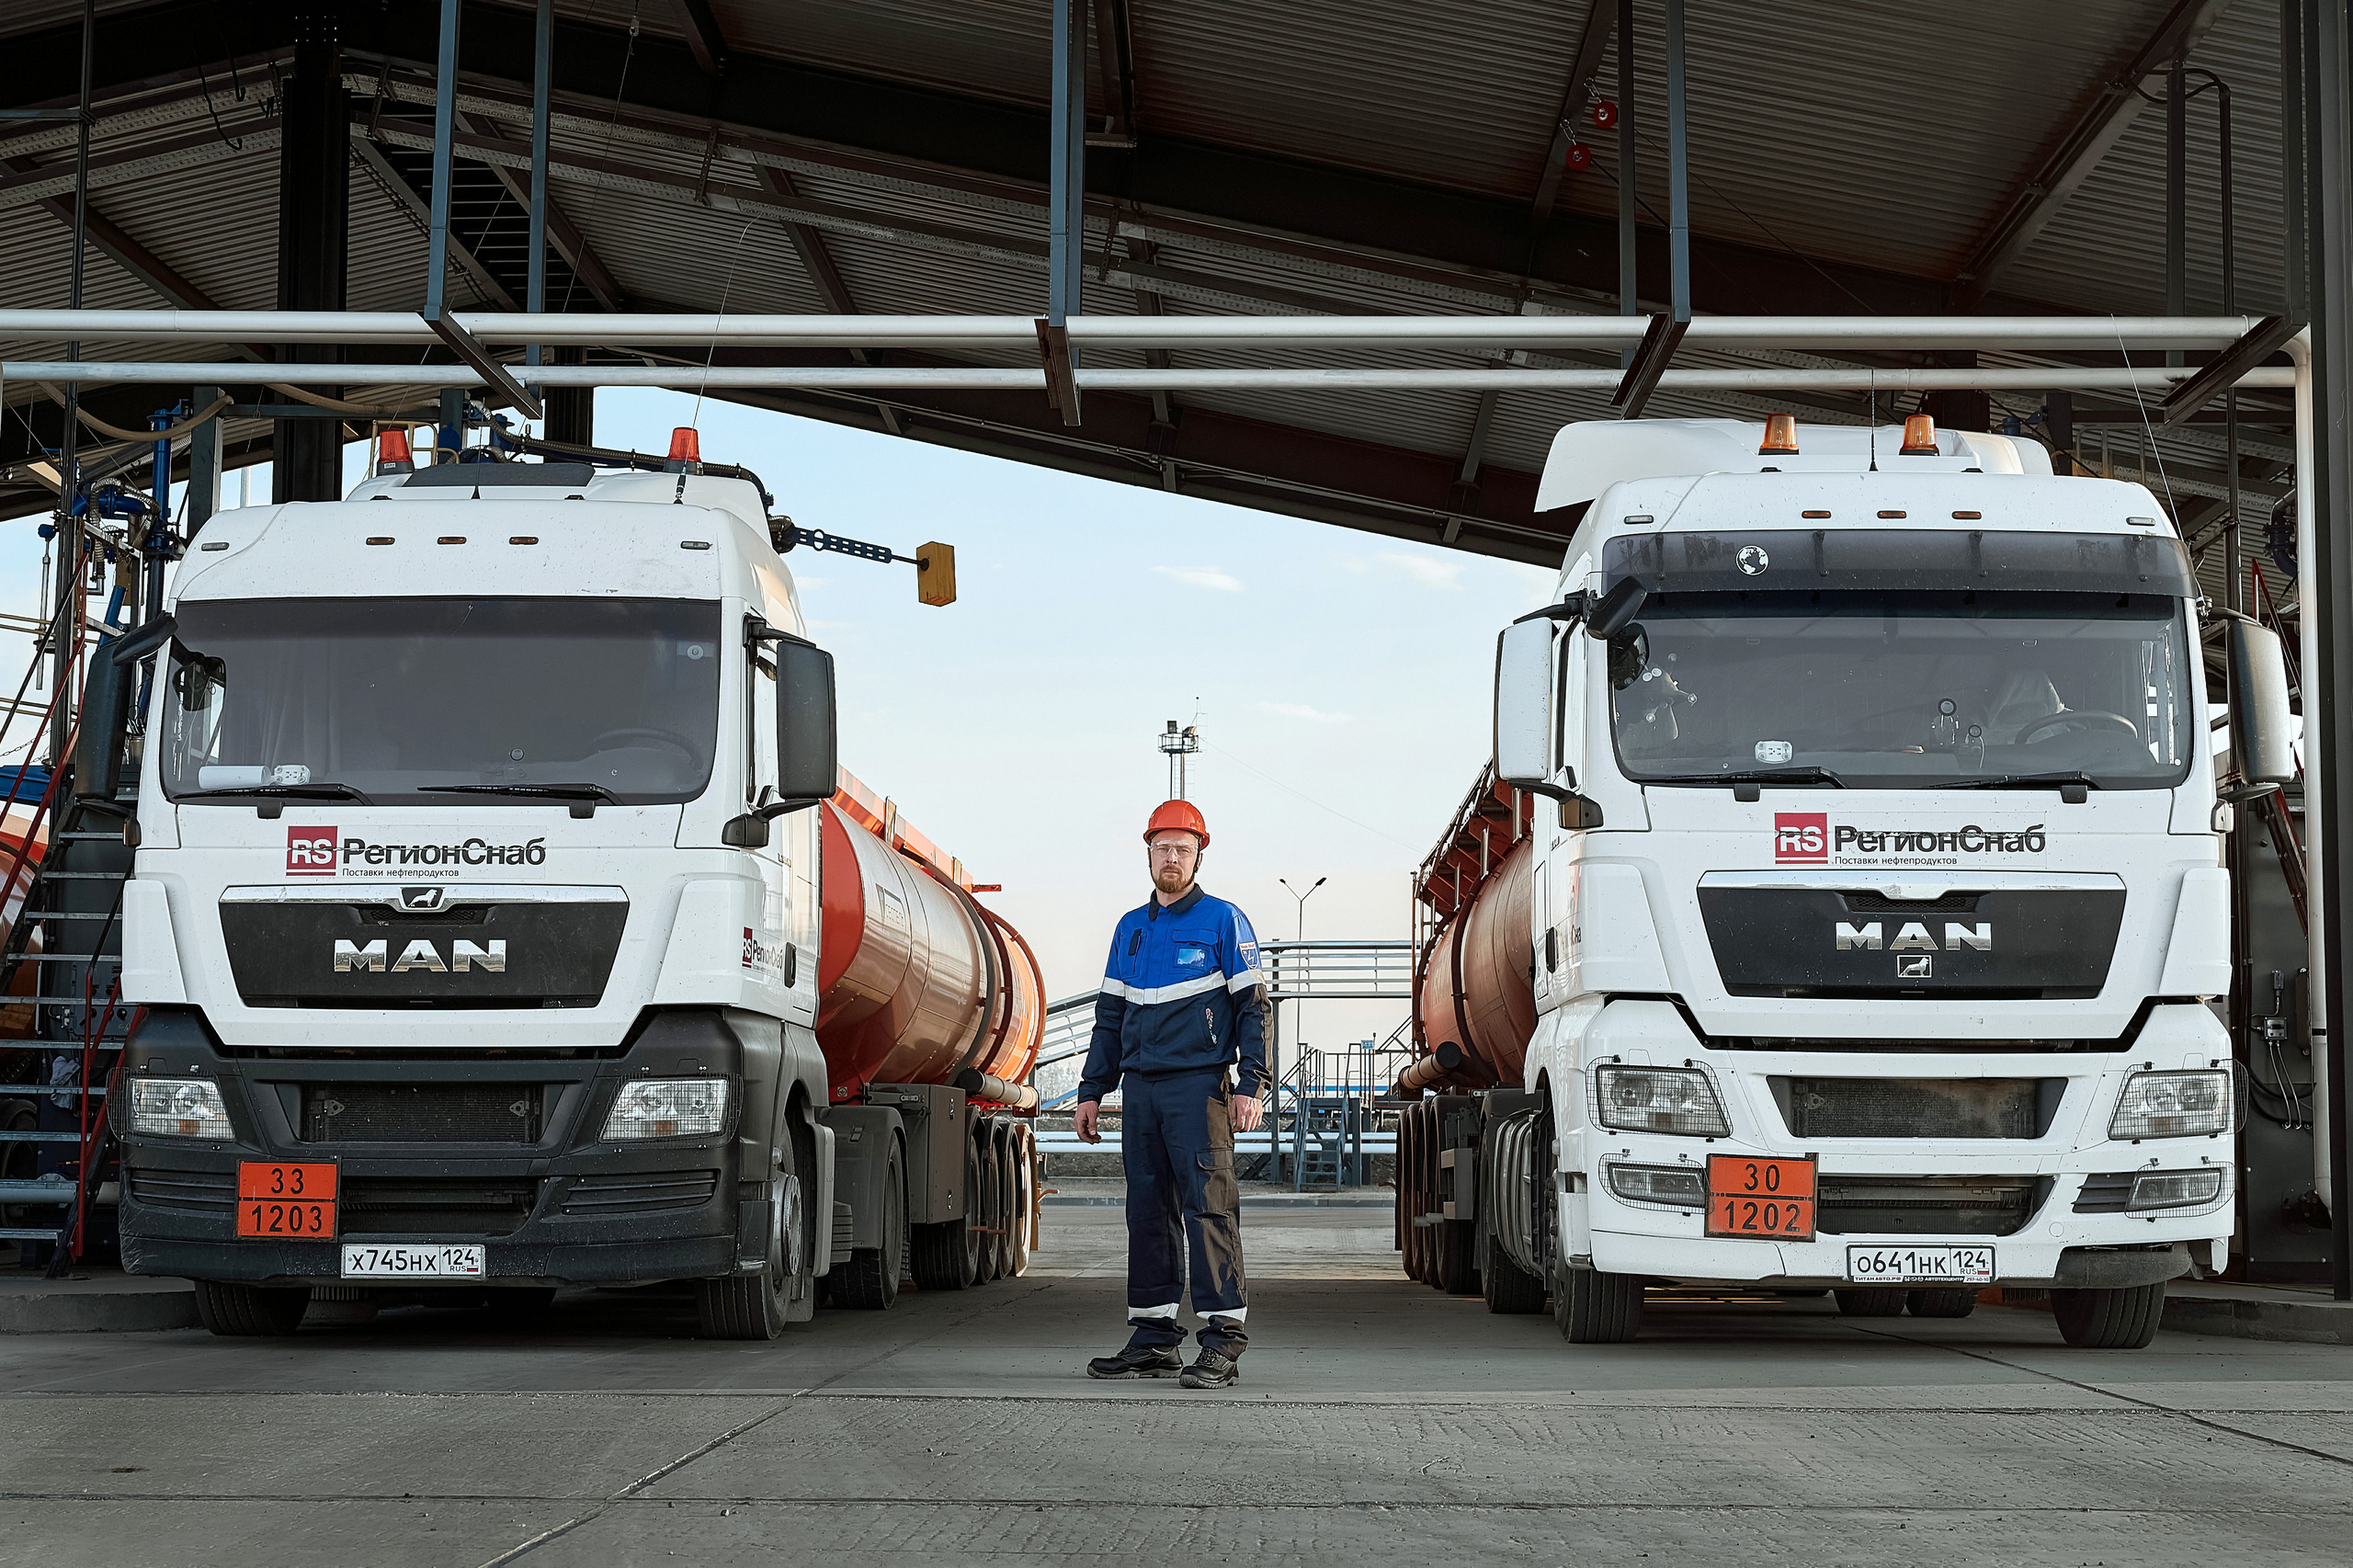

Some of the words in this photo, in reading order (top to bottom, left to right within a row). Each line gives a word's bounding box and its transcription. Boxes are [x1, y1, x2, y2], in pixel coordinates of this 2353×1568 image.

[290, 838, 334, 865] RS
[343, 836, 547, 866] РегионСнаб
[1779, 825, 1824, 853] RS
[1834, 824, 2046, 853] РегионСнаб
[342, 868, 384, 878] Поставки
[386, 868, 460, 880] нефтепродуктов
[1835, 856, 1879, 866] Поставки
[1881, 856, 1958, 867] нефтепродуктов
[1835, 921, 1993, 951] MAN
[334, 938, 506, 973] MAN
[270, 1167, 304, 1195] 33
[1744, 1163, 1780, 1192] 30
[251, 1204, 323, 1233] 1203
[1724, 1200, 1801, 1233] 1202
[442, 1247, 475, 1266] 124
[449, 1265, 467, 1273] RUS
[1952, 1250, 1986, 1268] 124
